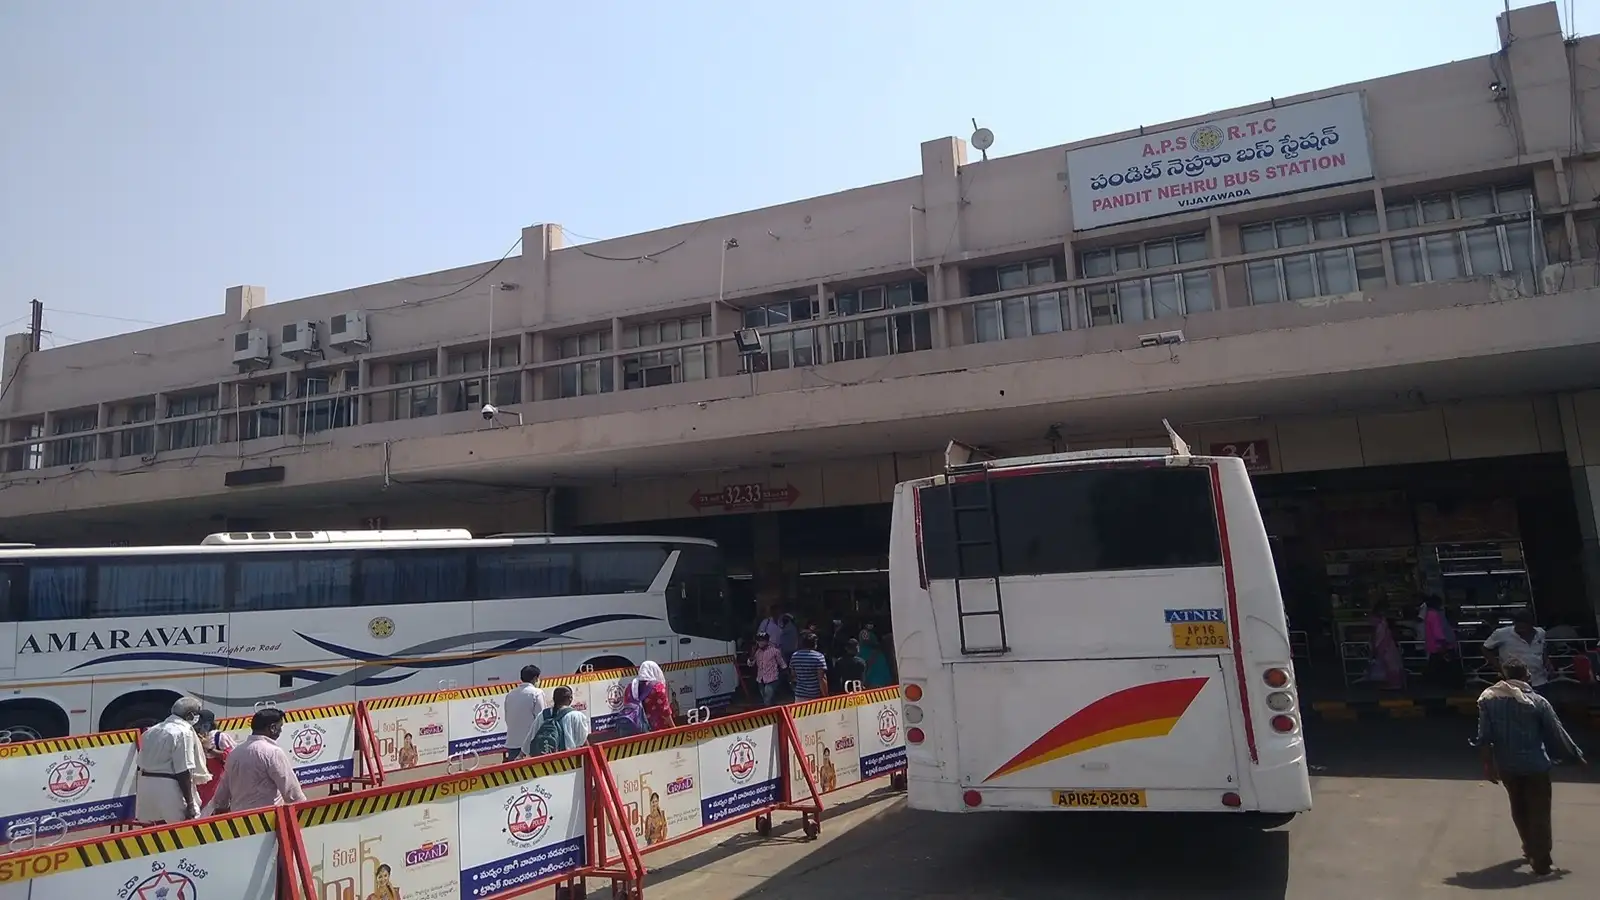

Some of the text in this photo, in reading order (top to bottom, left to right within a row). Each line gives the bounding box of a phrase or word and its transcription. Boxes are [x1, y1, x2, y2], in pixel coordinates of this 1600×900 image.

[1142, 135, 1188, 157] A.P.S
[1227, 118, 1277, 141] R.T.C
[1090, 159, 1163, 190] పండిట్
[1236, 140, 1275, 163] బస్
[1279, 125, 1340, 159] స్టేషన్
[1092, 152, 1346, 213] PANDIT NEHRU BUS STATION
[1178, 188, 1252, 208] VIJAYAWADA
[725, 483, 761, 504] 32-33
[1168, 610, 1219, 622] ATNR
[18, 624, 228, 654] AMARAVATI
[245, 645, 256, 653] on
[258, 642, 282, 652] Road
[1195, 635, 1225, 646] 0203
[438, 691, 459, 701] STOP
[848, 695, 866, 707] STOP
[686, 727, 710, 742] STOP
[440, 777, 478, 796] STOP
[667, 777, 693, 794] GRAND
[407, 844, 448, 864] GRAND
[0, 851, 70, 882] STOP
[117, 858, 208, 899] సదా మీ సేవలో
